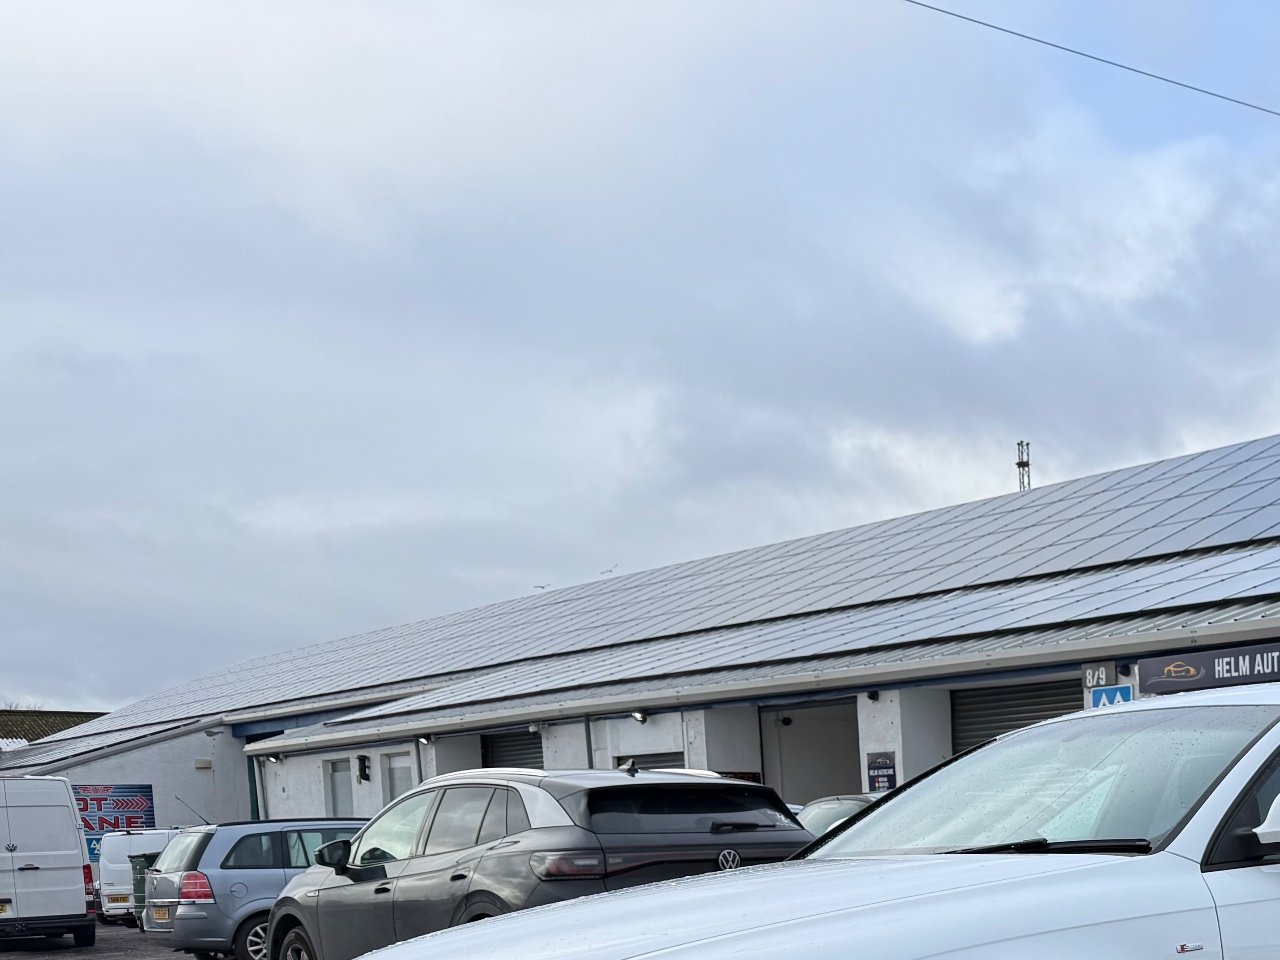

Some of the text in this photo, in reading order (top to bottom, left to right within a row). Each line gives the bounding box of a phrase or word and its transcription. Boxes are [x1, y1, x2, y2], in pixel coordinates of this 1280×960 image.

[1214, 655, 1250, 679] HELM
[1086, 667, 1106, 687] 8/9
[75, 797, 109, 812] OT
[81, 815, 144, 831] ANE
